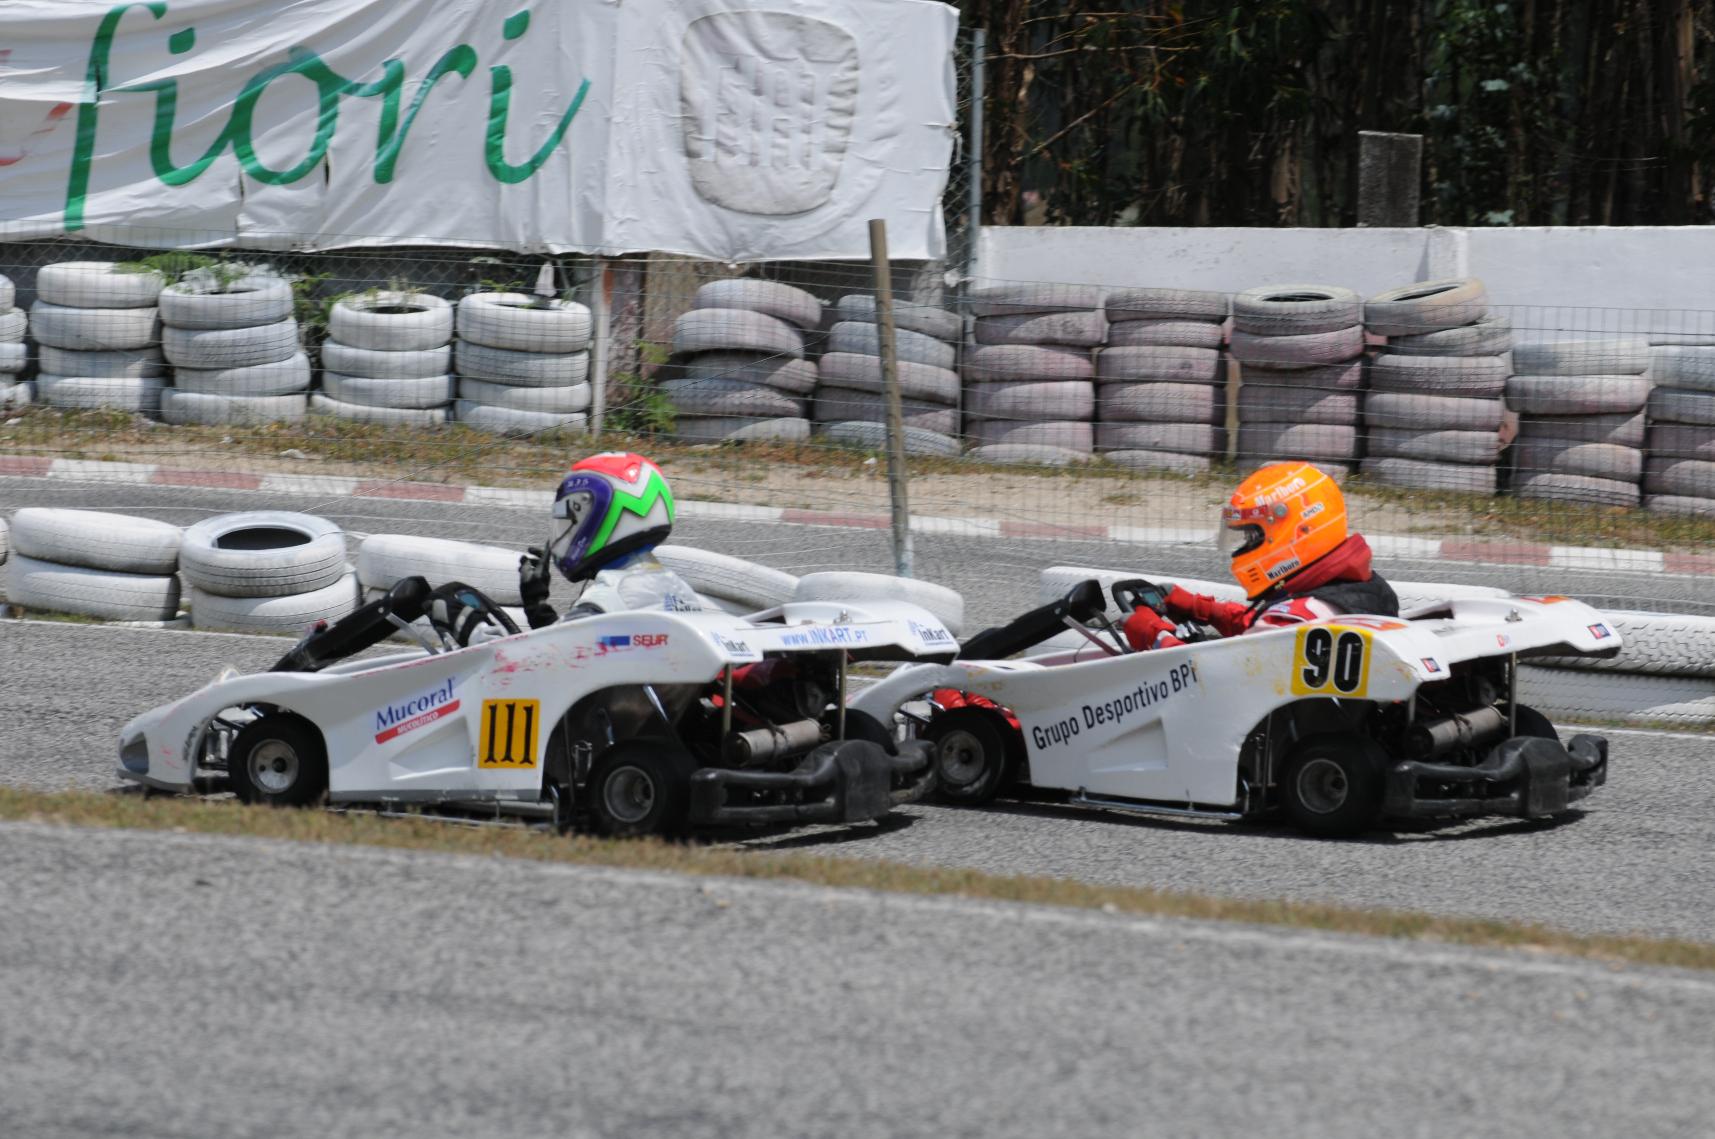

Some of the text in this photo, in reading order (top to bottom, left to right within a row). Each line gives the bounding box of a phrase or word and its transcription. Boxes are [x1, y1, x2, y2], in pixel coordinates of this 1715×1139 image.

[63, 2, 590, 231] fiori
[633, 634, 669, 647] SEUR
[1302, 627, 1364, 693] 90
[376, 678, 455, 731] Mucoral
[484, 702, 535, 765] 111
[1032, 715, 1079, 750] Grupo
[1082, 681, 1168, 729] Desportivo
